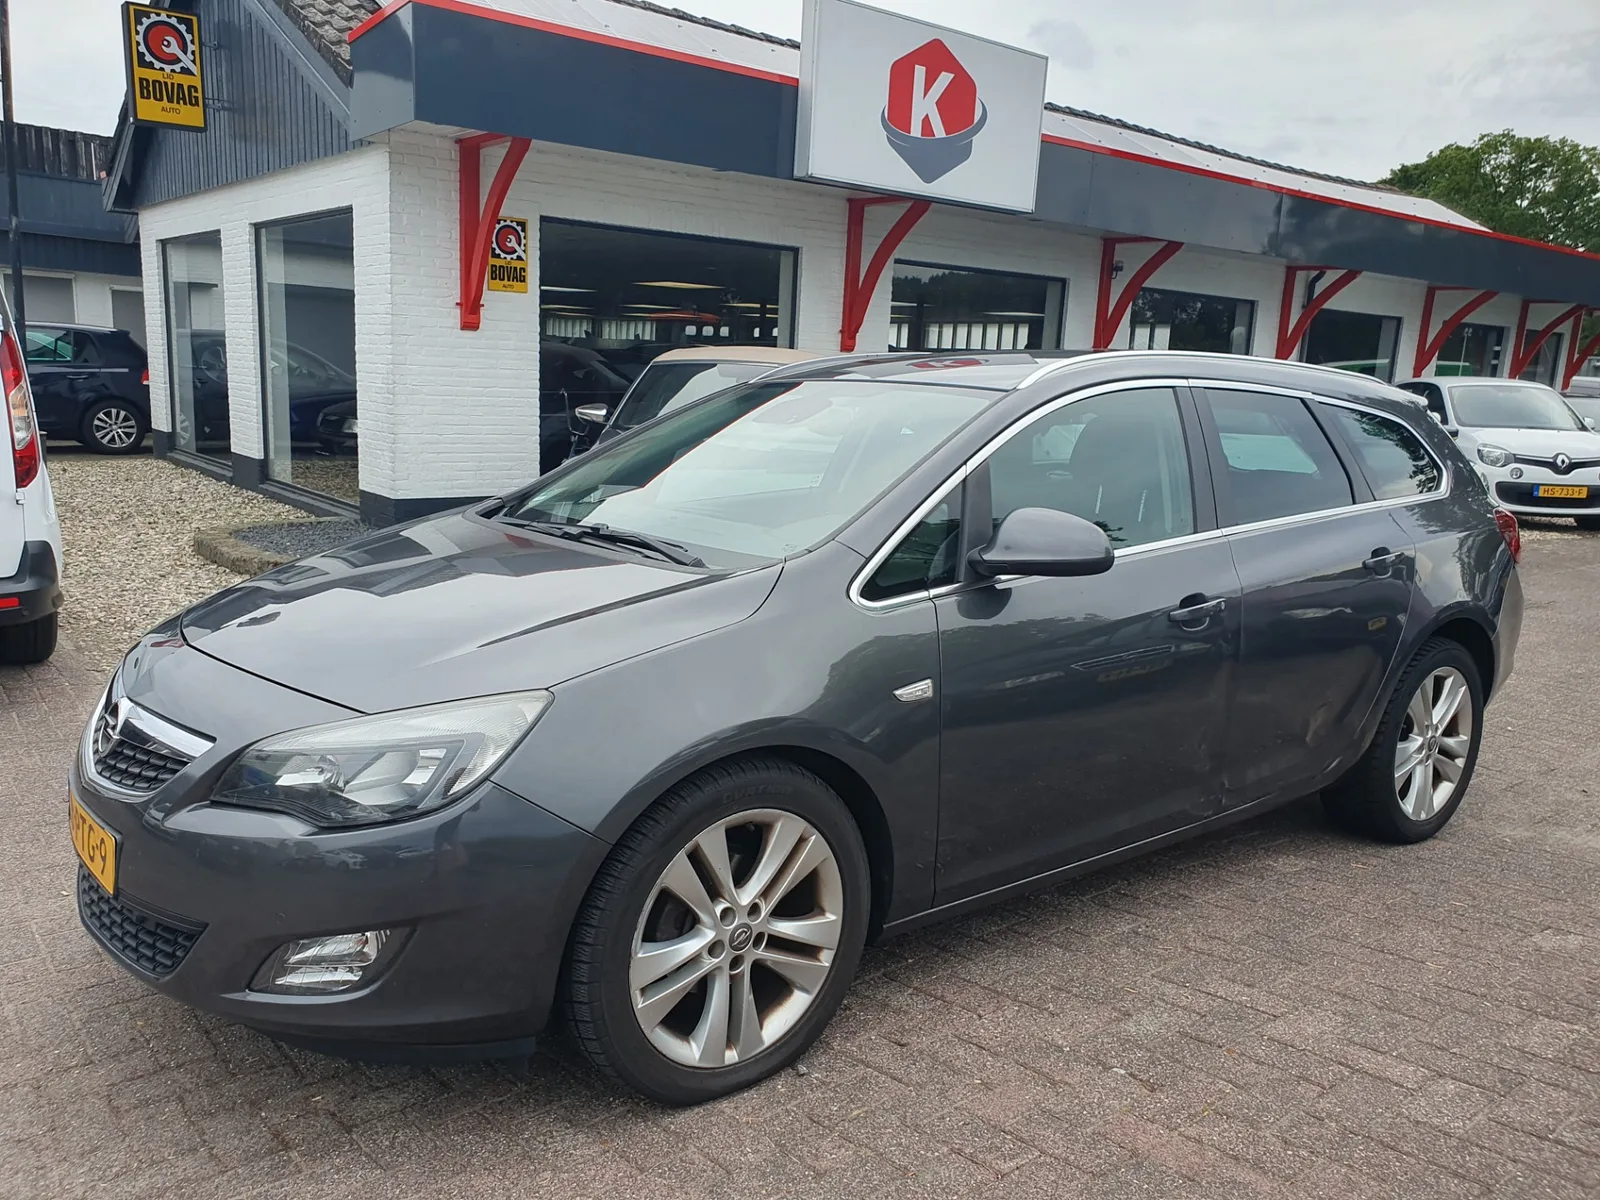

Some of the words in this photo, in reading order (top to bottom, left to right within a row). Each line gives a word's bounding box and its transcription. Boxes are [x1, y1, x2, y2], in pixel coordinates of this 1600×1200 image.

[162, 72, 174, 80] LID
[138, 77, 200, 108] BOVAG
[910, 64, 955, 137] K
[161, 106, 180, 115] AUTO
[490, 264, 526, 283] BOVAG
[1542, 486, 1584, 497] HS-733-F
